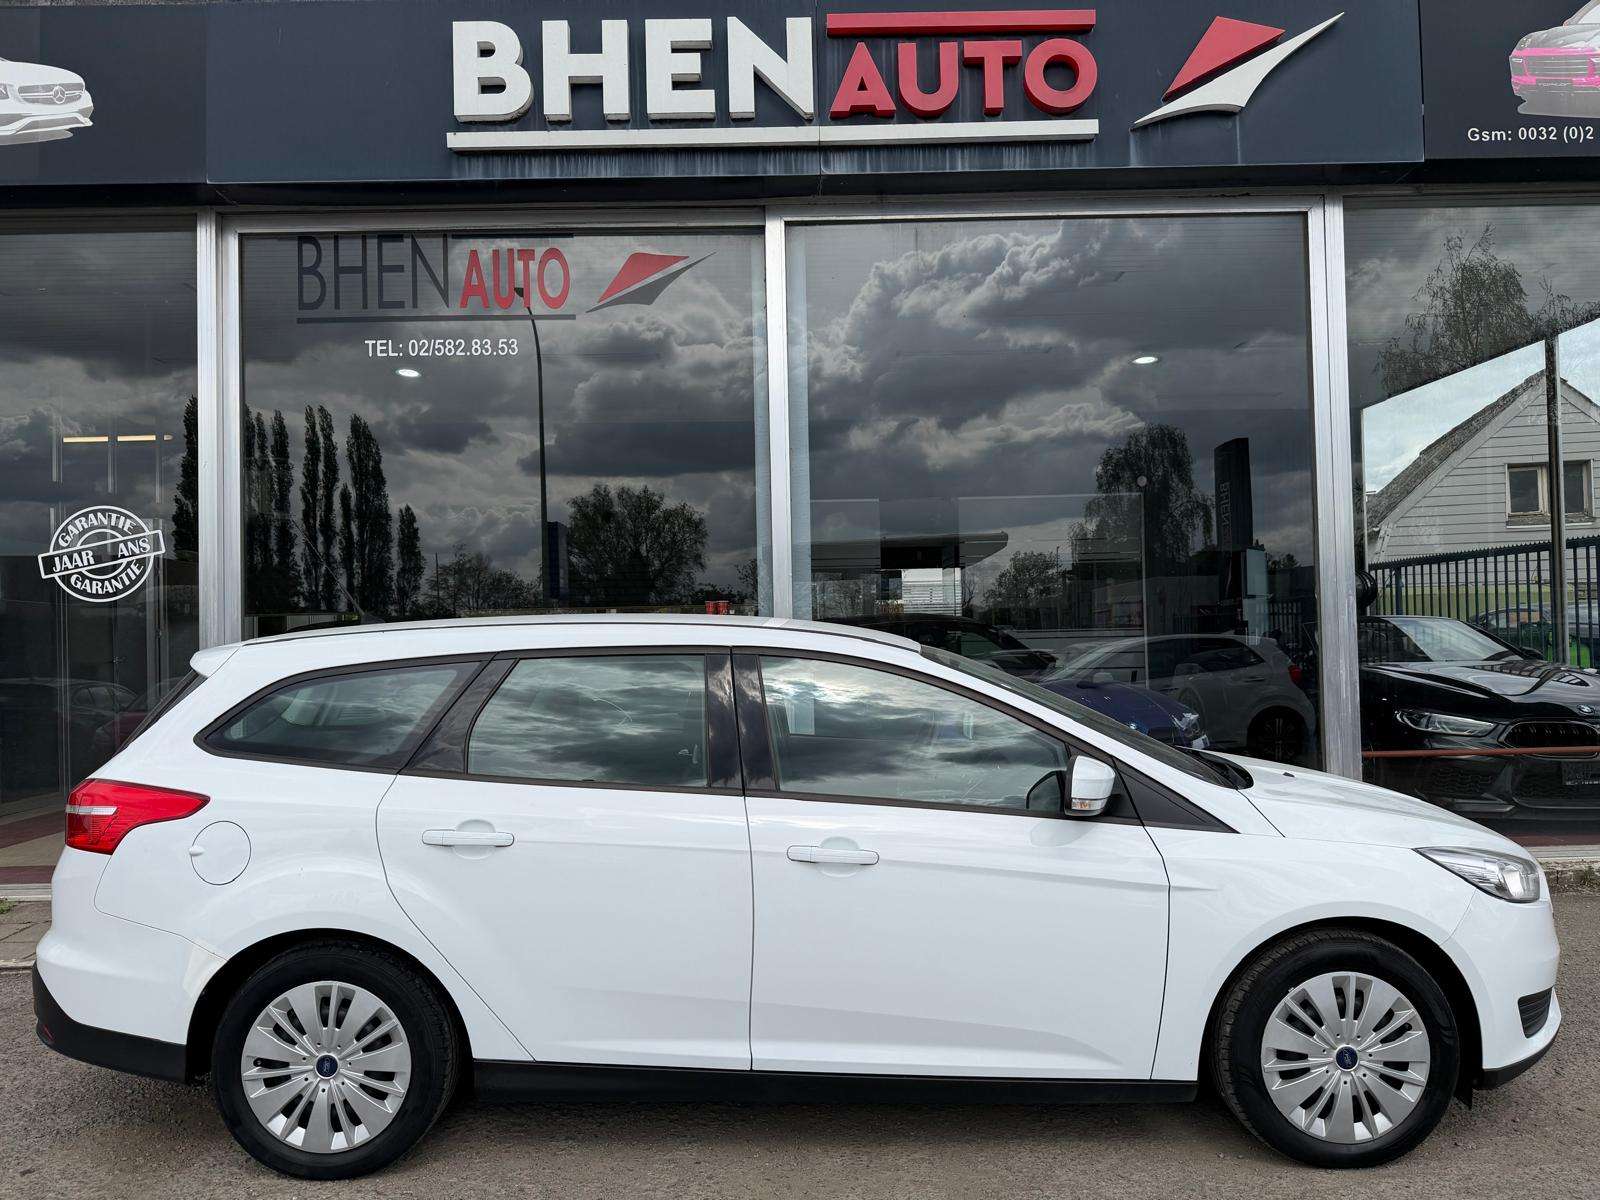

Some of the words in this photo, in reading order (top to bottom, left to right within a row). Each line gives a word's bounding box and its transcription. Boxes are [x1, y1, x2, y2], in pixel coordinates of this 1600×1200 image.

[452, 17, 814, 122] BHEN
[829, 38, 1098, 118] AUTO
[1467, 127, 1513, 142] Gsm:
[1518, 126, 1558, 141] 0032
[1563, 125, 1594, 144] (0)2
[298, 232, 450, 311] BHEN
[459, 247, 571, 309] AUTO
[364, 339, 403, 357] TEL:
[408, 338, 519, 357] 02/582.83.53
[58, 511, 137, 547] GARANTIE
[52, 549, 95, 573] JAAR
[117, 537, 151, 558] ANS
[70, 560, 144, 594] GARANTIE
